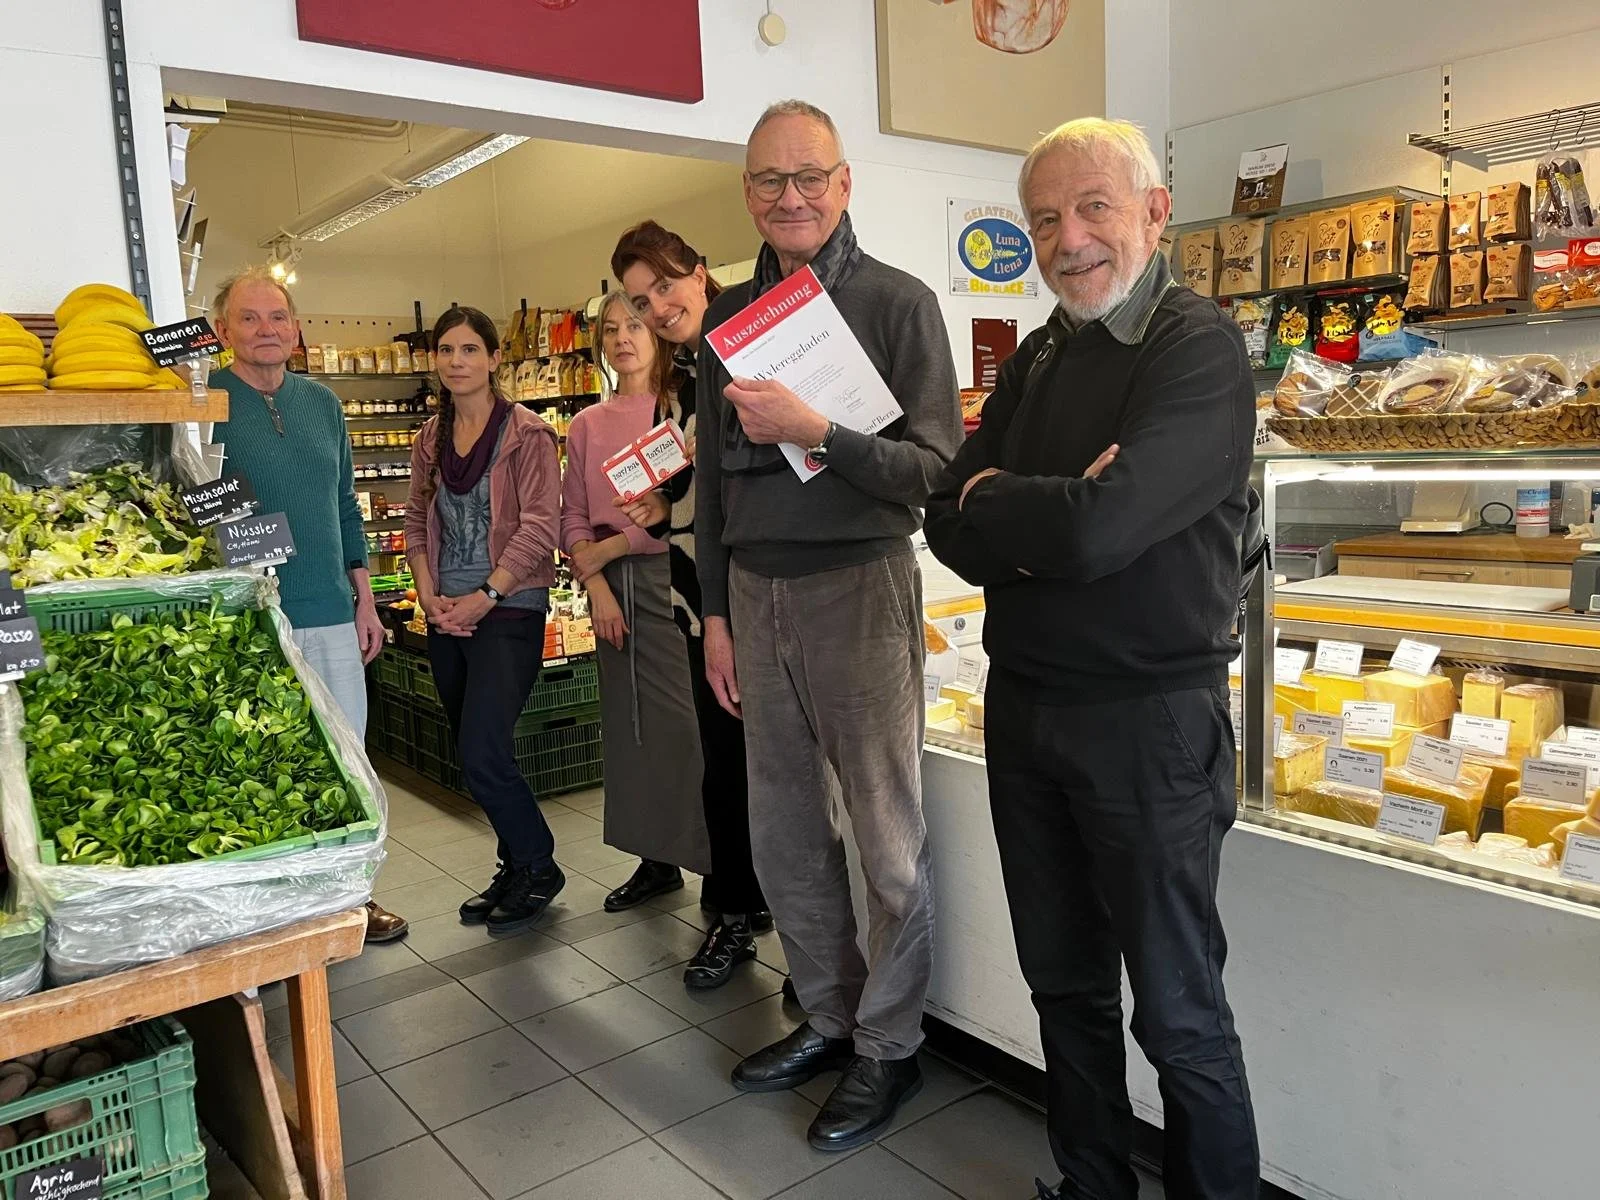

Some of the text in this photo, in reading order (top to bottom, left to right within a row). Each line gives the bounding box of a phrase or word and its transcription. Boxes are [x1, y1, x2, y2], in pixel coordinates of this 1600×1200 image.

[995, 233, 1020, 246] Luna
[994, 257, 1023, 274] Llena
[723, 283, 814, 351] Auszeichnung
[144, 324, 203, 346] Bananen
[754, 329, 830, 381] Wylereggladen
[876, 410, 896, 425] Bern
[182, 479, 240, 507] Mischsalat
[197, 512, 224, 526] Demeter
[227, 522, 278, 539] Nüssler
[230, 553, 257, 564] demeter
[30, 1168, 74, 1195] Agria
